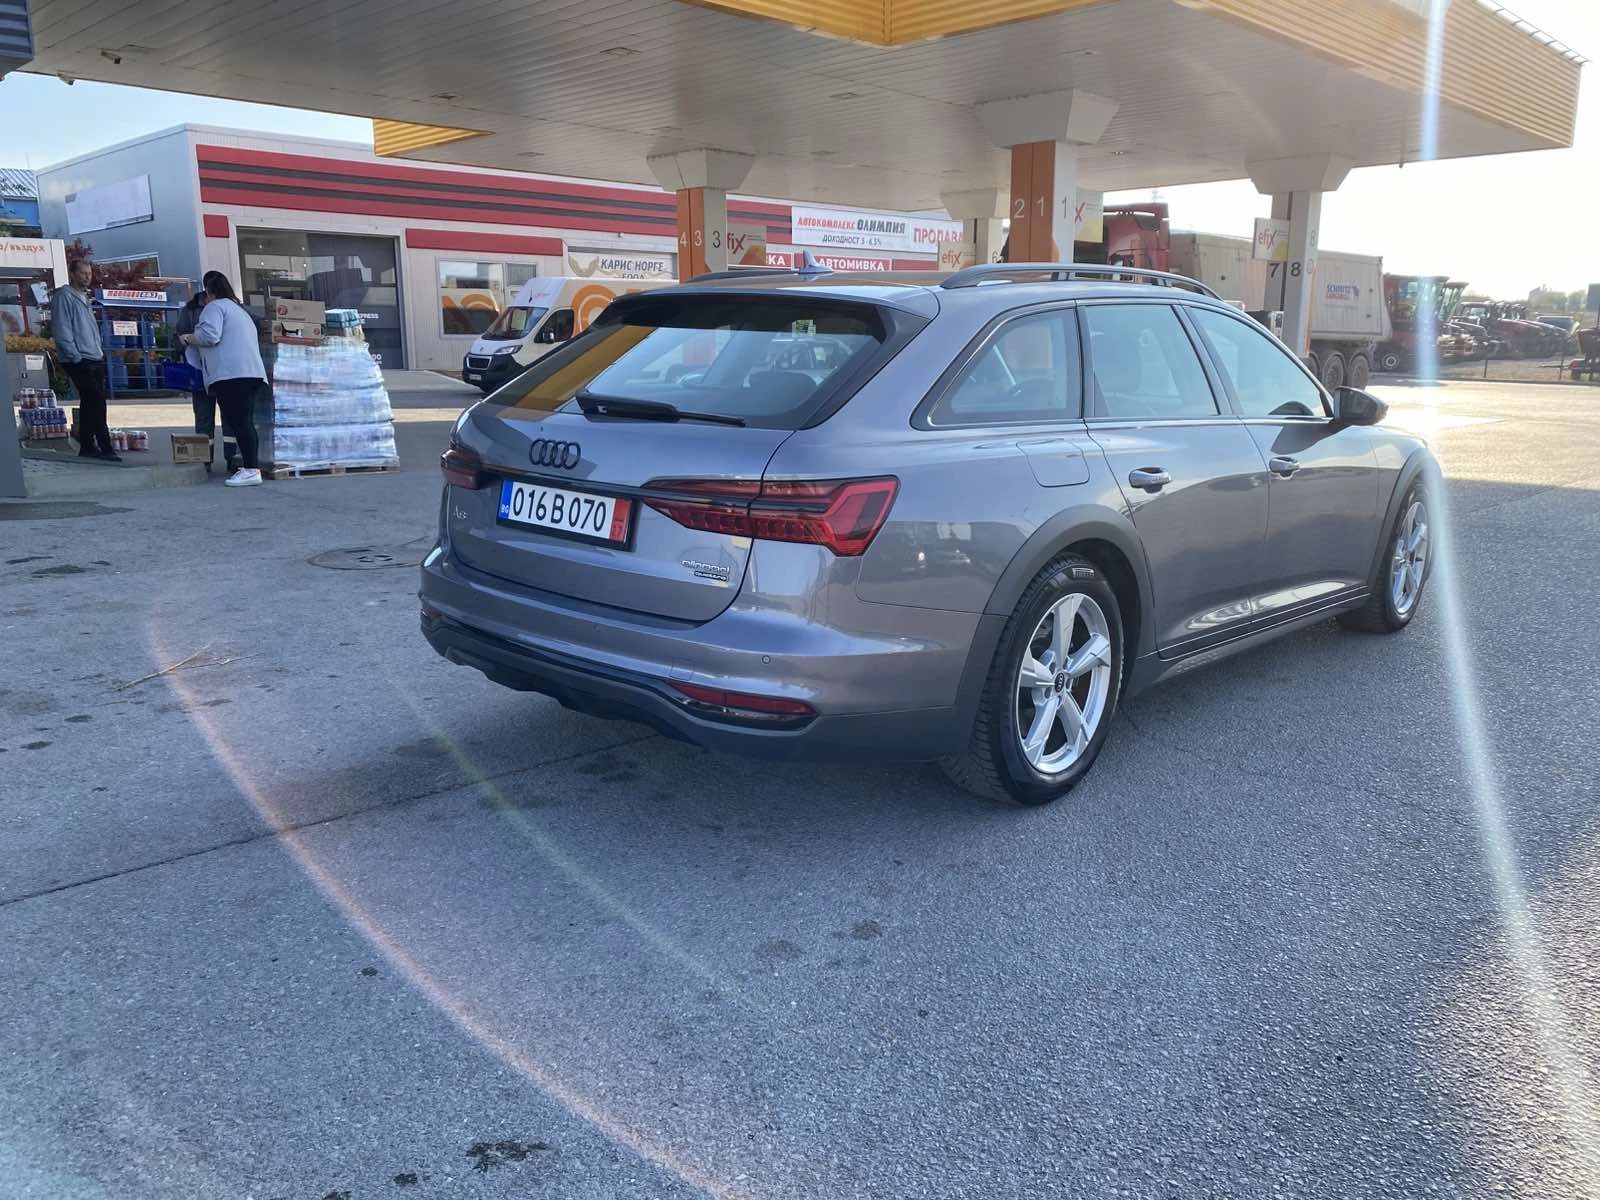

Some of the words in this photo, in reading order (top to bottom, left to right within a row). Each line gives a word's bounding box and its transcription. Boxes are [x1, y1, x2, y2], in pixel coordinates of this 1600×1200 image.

[1014, 198, 1025, 218] 2
[1035, 195, 1045, 216] 1
[857, 219, 906, 234] ОЛИМПИЯ
[680, 231, 688, 247] 4
[694, 229, 702, 247] 3
[712, 230, 720, 248] 3
[727, 232, 747, 254] fix
[601, 258, 632, 271] КАРИС
[635, 260, 663, 272] НОРГЕ
[766, 255, 786, 265] КА
[819, 258, 885, 273] АВТОМИВКА
[1269, 262, 1279, 278] 7
[1290, 262, 1301, 277] 8
[513, 487, 607, 532] 016B070
